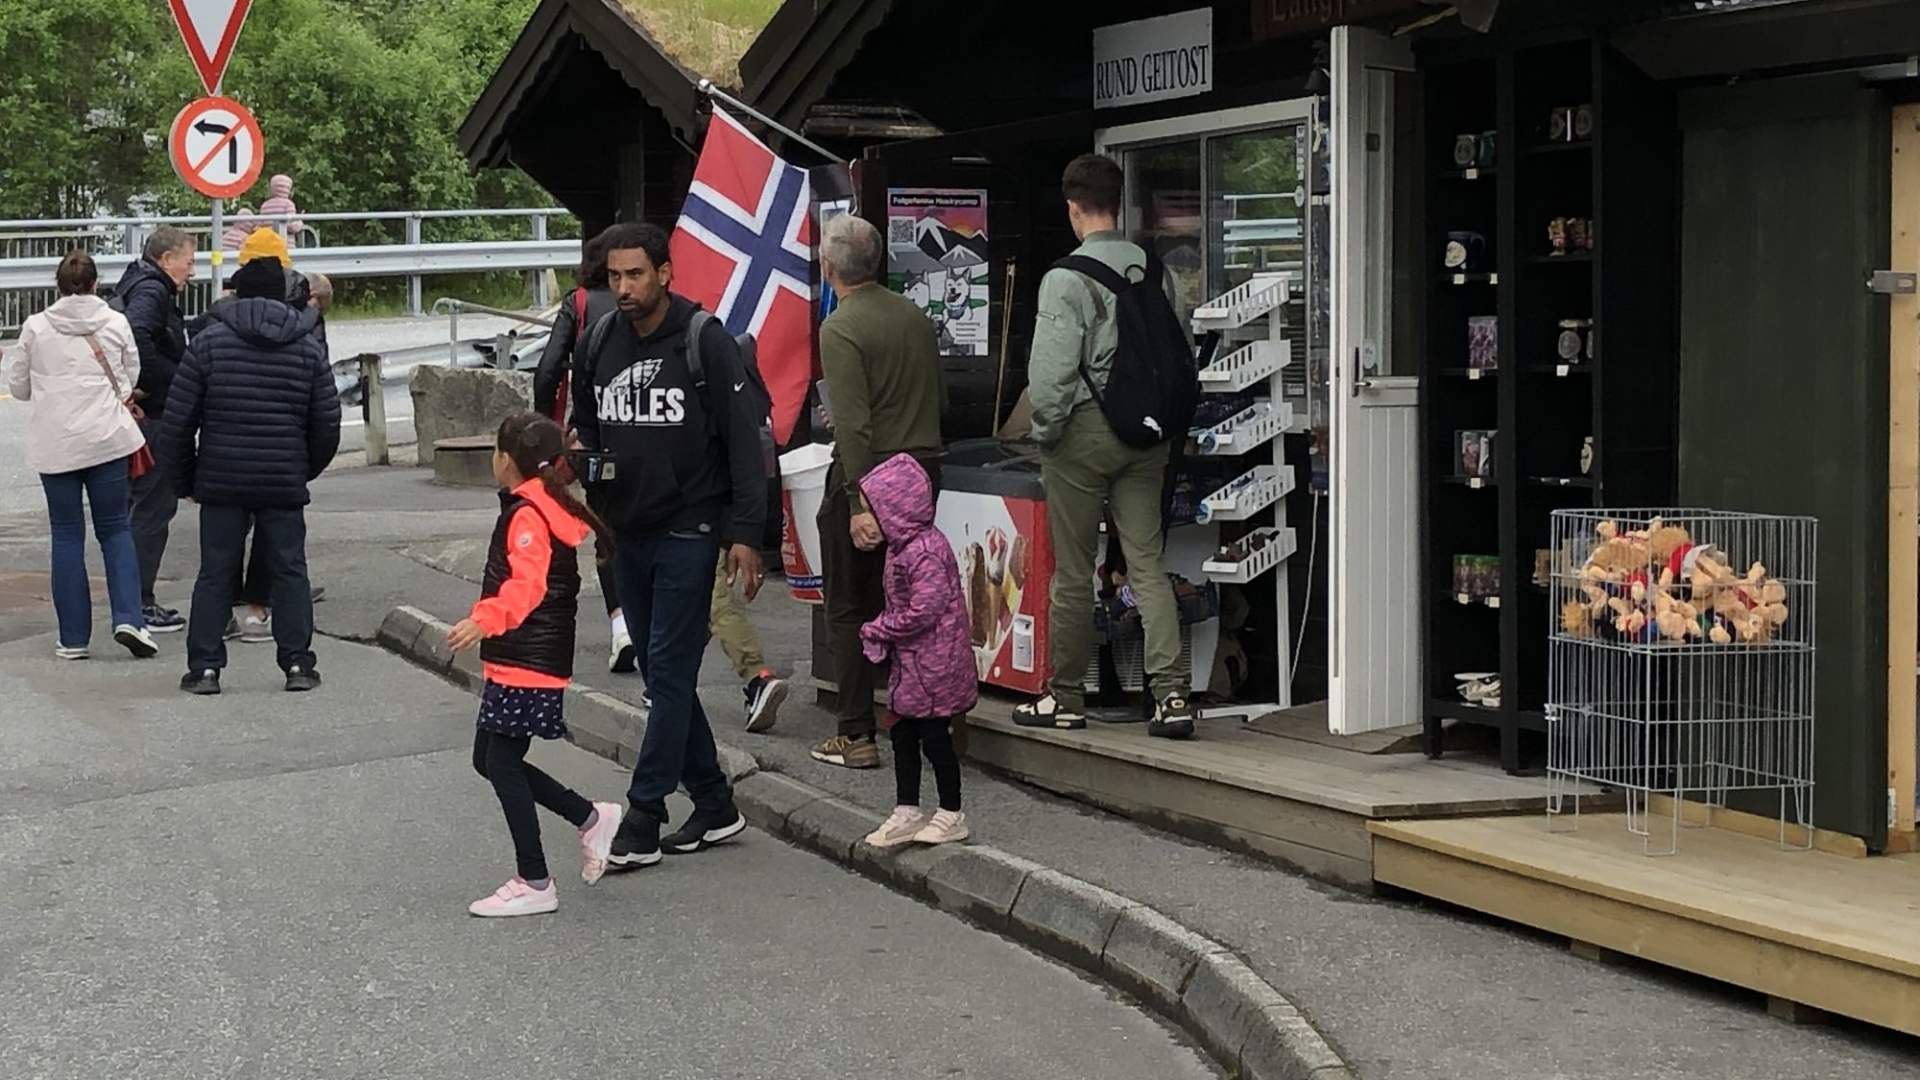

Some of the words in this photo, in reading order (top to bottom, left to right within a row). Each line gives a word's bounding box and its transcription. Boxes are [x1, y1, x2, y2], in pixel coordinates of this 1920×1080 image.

[1096, 57, 1137, 100] RUND
[1142, 44, 1209, 93] GEITOST
[594, 385, 685, 422] EAGLES
